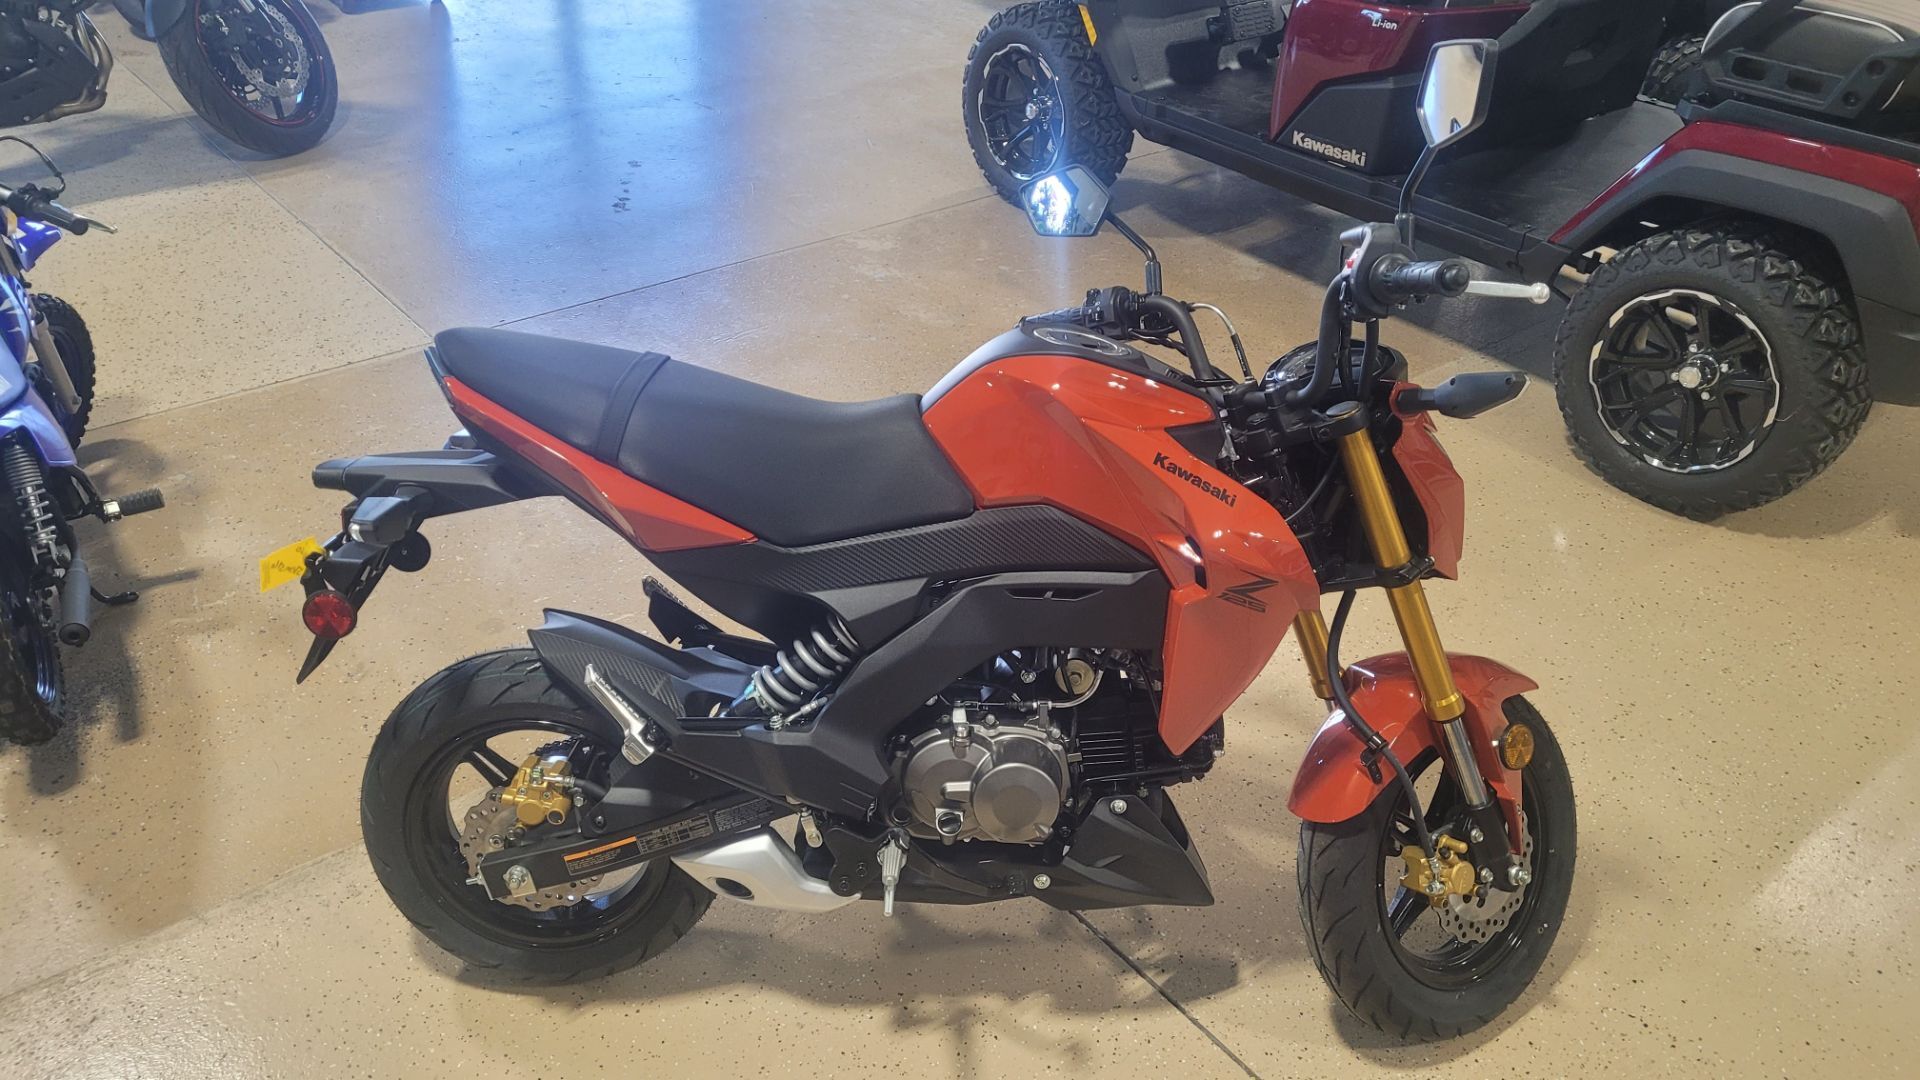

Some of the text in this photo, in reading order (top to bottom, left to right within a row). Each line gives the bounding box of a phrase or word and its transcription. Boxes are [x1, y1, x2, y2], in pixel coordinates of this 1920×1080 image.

[1371, 19, 1398, 31] Li-ion
[1292, 130, 1367, 167] Kawasaki
[1152, 452, 1237, 508] Kawasaki
[1216, 591, 1267, 614] 125
[1224, 568, 1280, 605] Z
